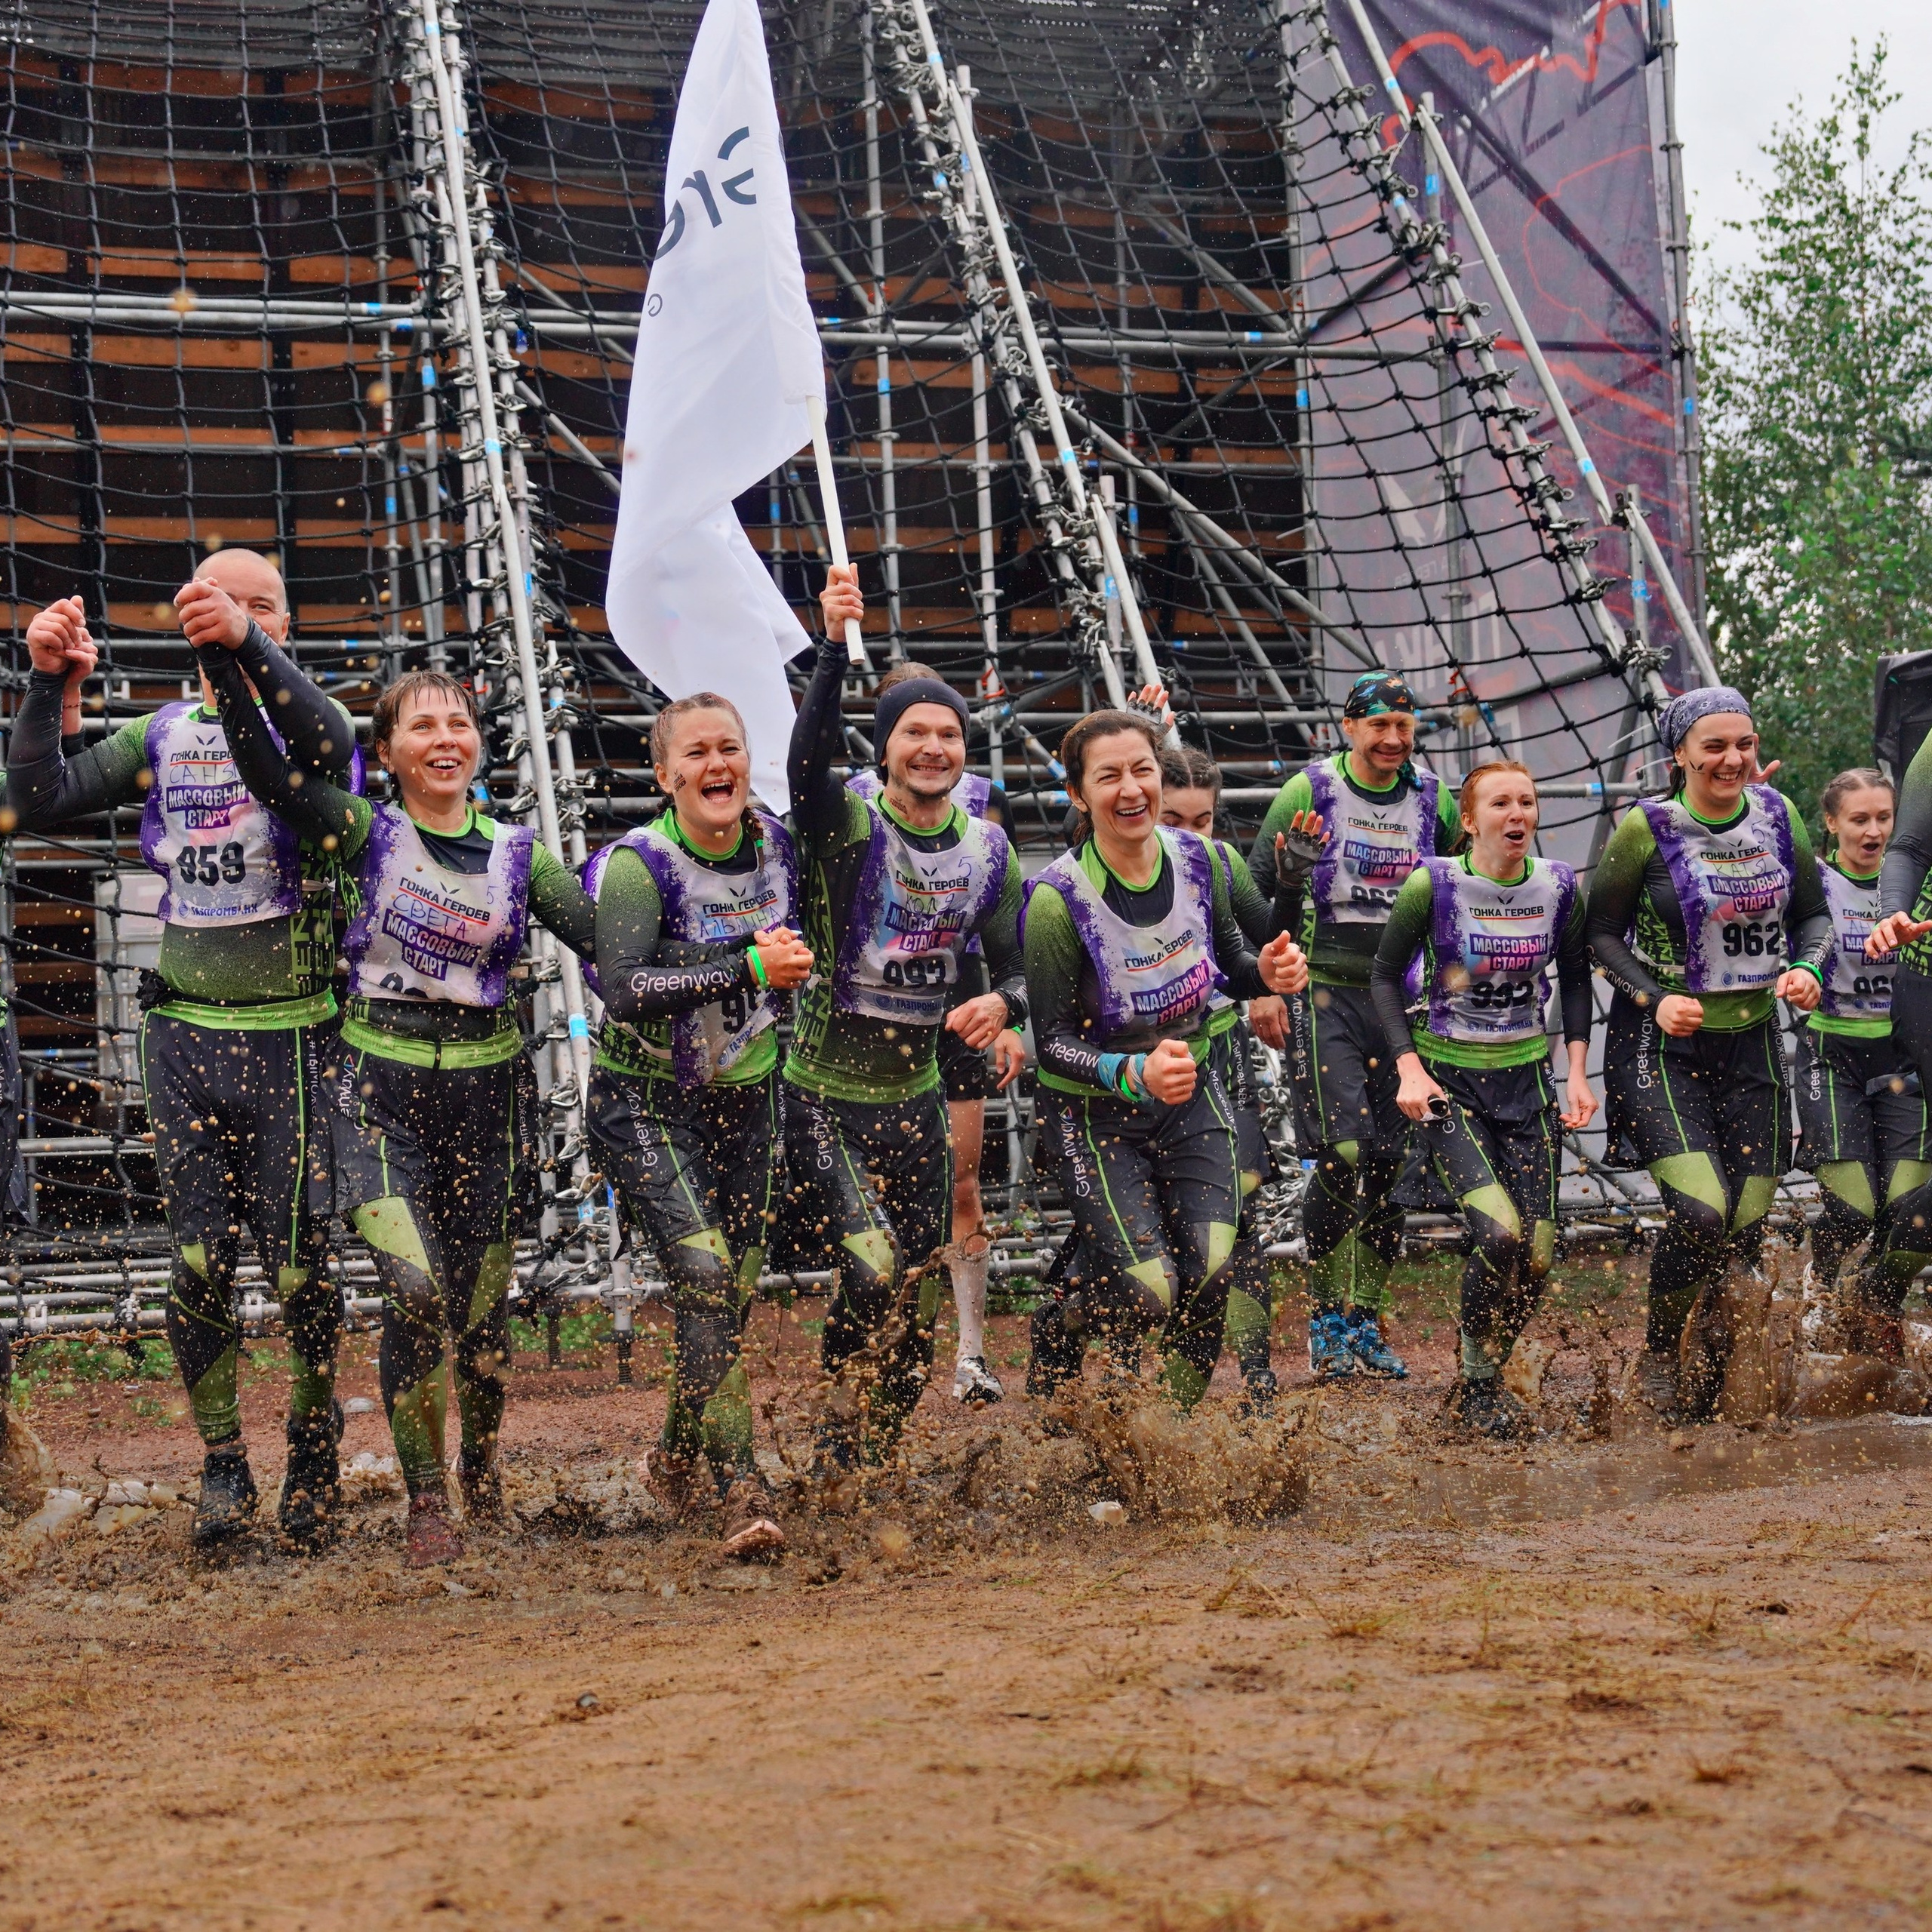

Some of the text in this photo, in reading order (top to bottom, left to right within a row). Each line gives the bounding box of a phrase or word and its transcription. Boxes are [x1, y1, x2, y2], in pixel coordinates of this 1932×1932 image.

[168, 779, 246, 808] МАССОВЫЙ
[187, 809, 228, 827] СТАРТ
[1348, 817, 1408, 832] ГОНКА ГЕРОЕВ
[1346, 843, 1411, 863] МАССОВЫЙ
[1700, 845, 1767, 860] ГОНКА ГЕРО
[175, 841, 246, 886] 959
[1360, 863, 1394, 877] СТАРТ
[929, 878, 970, 891] ГЕРОЕВ
[1712, 869, 1784, 894] МАССОВЫЙ
[399, 877, 491, 921] ГОНКА ГЕРОЕВ
[738, 889, 777, 911] ГЕРОЕВ
[1734, 894, 1773, 912] СТАРТ
[1469, 906, 1544, 917] ГОНКА ГЕРОЕВ
[1843, 909, 1872, 918] ГОНКА
[386, 913, 478, 963] МАССОВЫЙ
[1473, 934, 1547, 954] МАССОВЫЙ
[1722, 921, 1780, 957] 962
[404, 946, 446, 977] СТАРТ
[1124, 952, 1162, 968] ГОНКА
[1492, 955, 1531, 971] СТАРТ
[630, 971, 732, 992] Greenway
[1135, 961, 1208, 1012] МАССОВЫЙ
[1159, 994, 1198, 1024] СТАРТ
